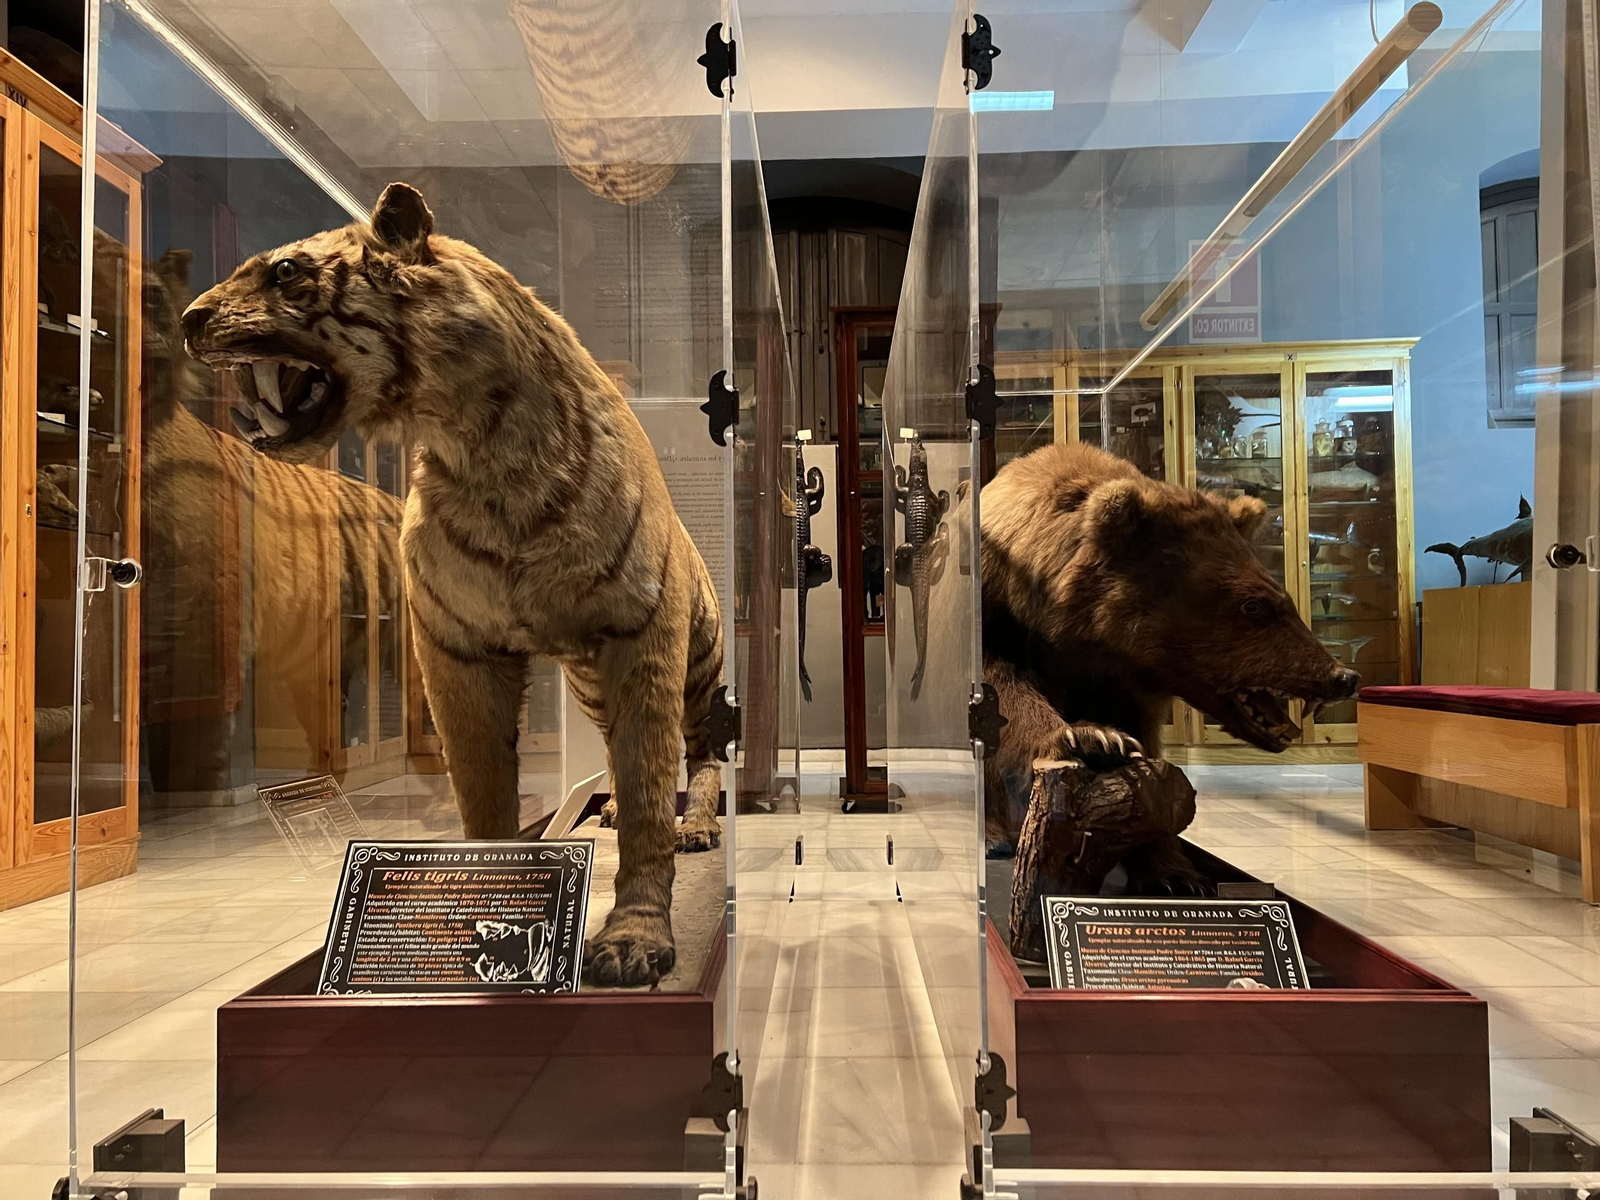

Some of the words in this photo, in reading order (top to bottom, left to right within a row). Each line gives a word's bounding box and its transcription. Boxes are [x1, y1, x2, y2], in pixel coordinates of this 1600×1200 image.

[8, 85, 28, 108] XIV
[404, 854, 460, 862] INSTITUTO
[484, 853, 534, 861] GRANADA
[382, 870, 421, 880] Felis
[424, 870, 469, 883] tigris
[1103, 909, 1160, 917] INSTITUTO
[1183, 910, 1234, 918] GRANADA
[339, 897, 357, 952] GABINETE
[562, 899, 575, 949] NATURAL
[1085, 925, 1132, 936] Ursus
[1135, 926, 1187, 936] arctos
